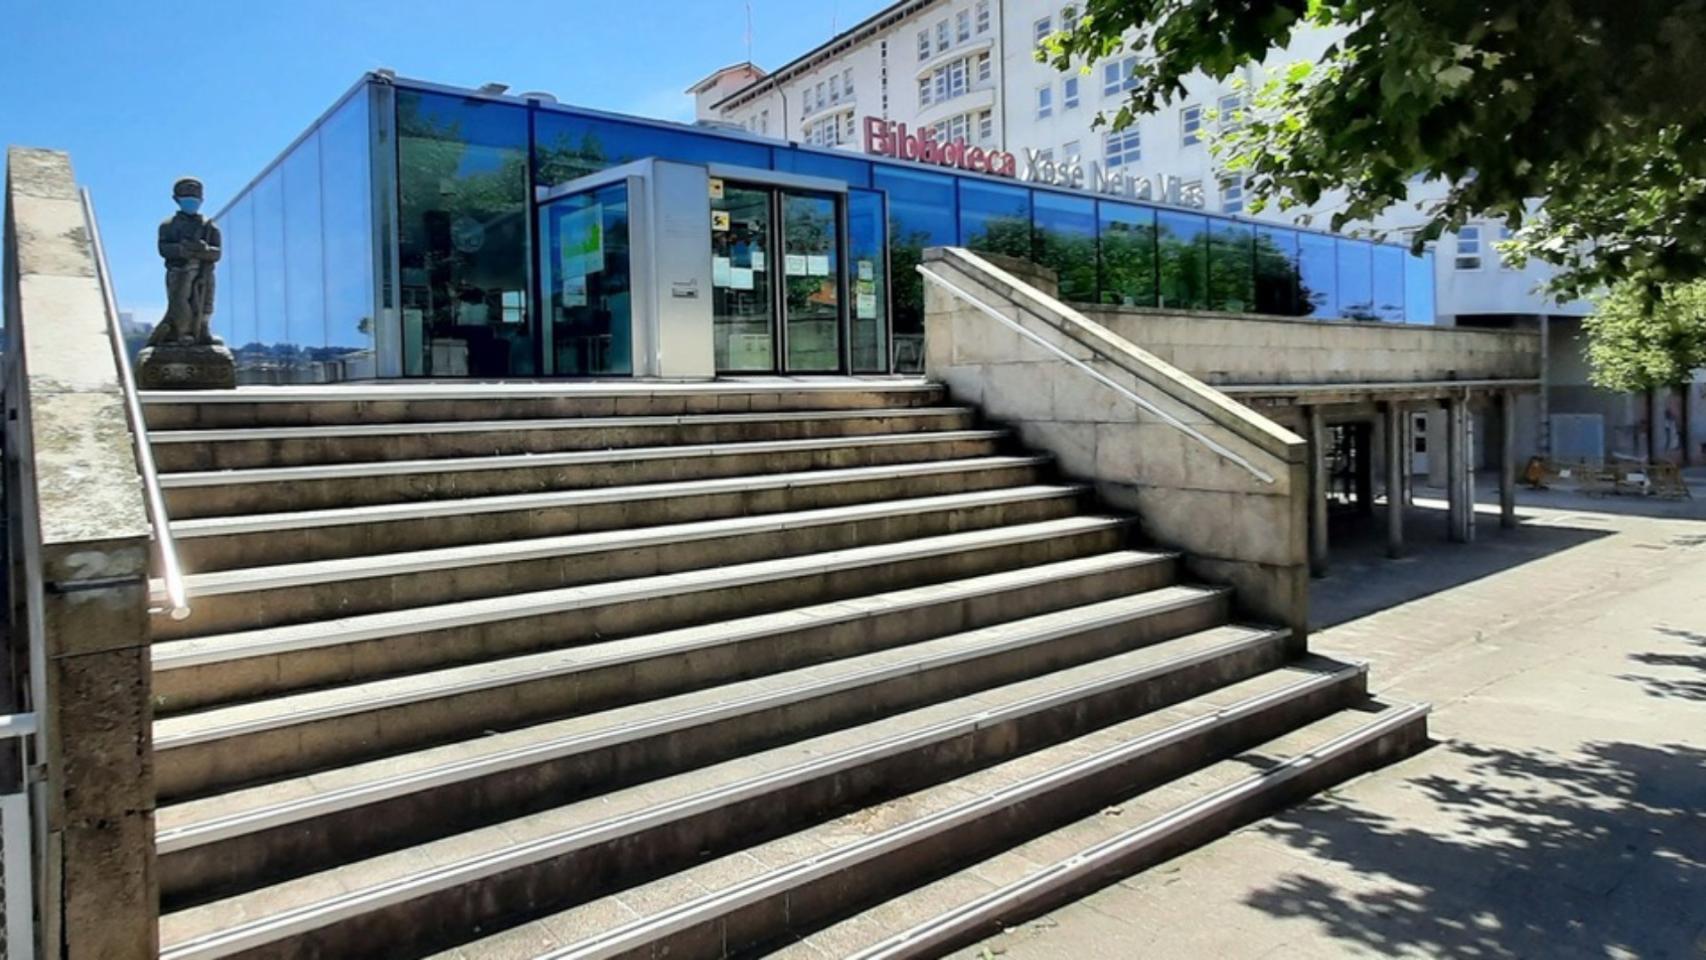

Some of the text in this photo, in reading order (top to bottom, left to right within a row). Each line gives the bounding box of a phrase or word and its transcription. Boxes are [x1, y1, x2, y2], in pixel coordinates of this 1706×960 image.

[864, 116, 1206, 209] Biblioteca Xosé Neira Vilas
